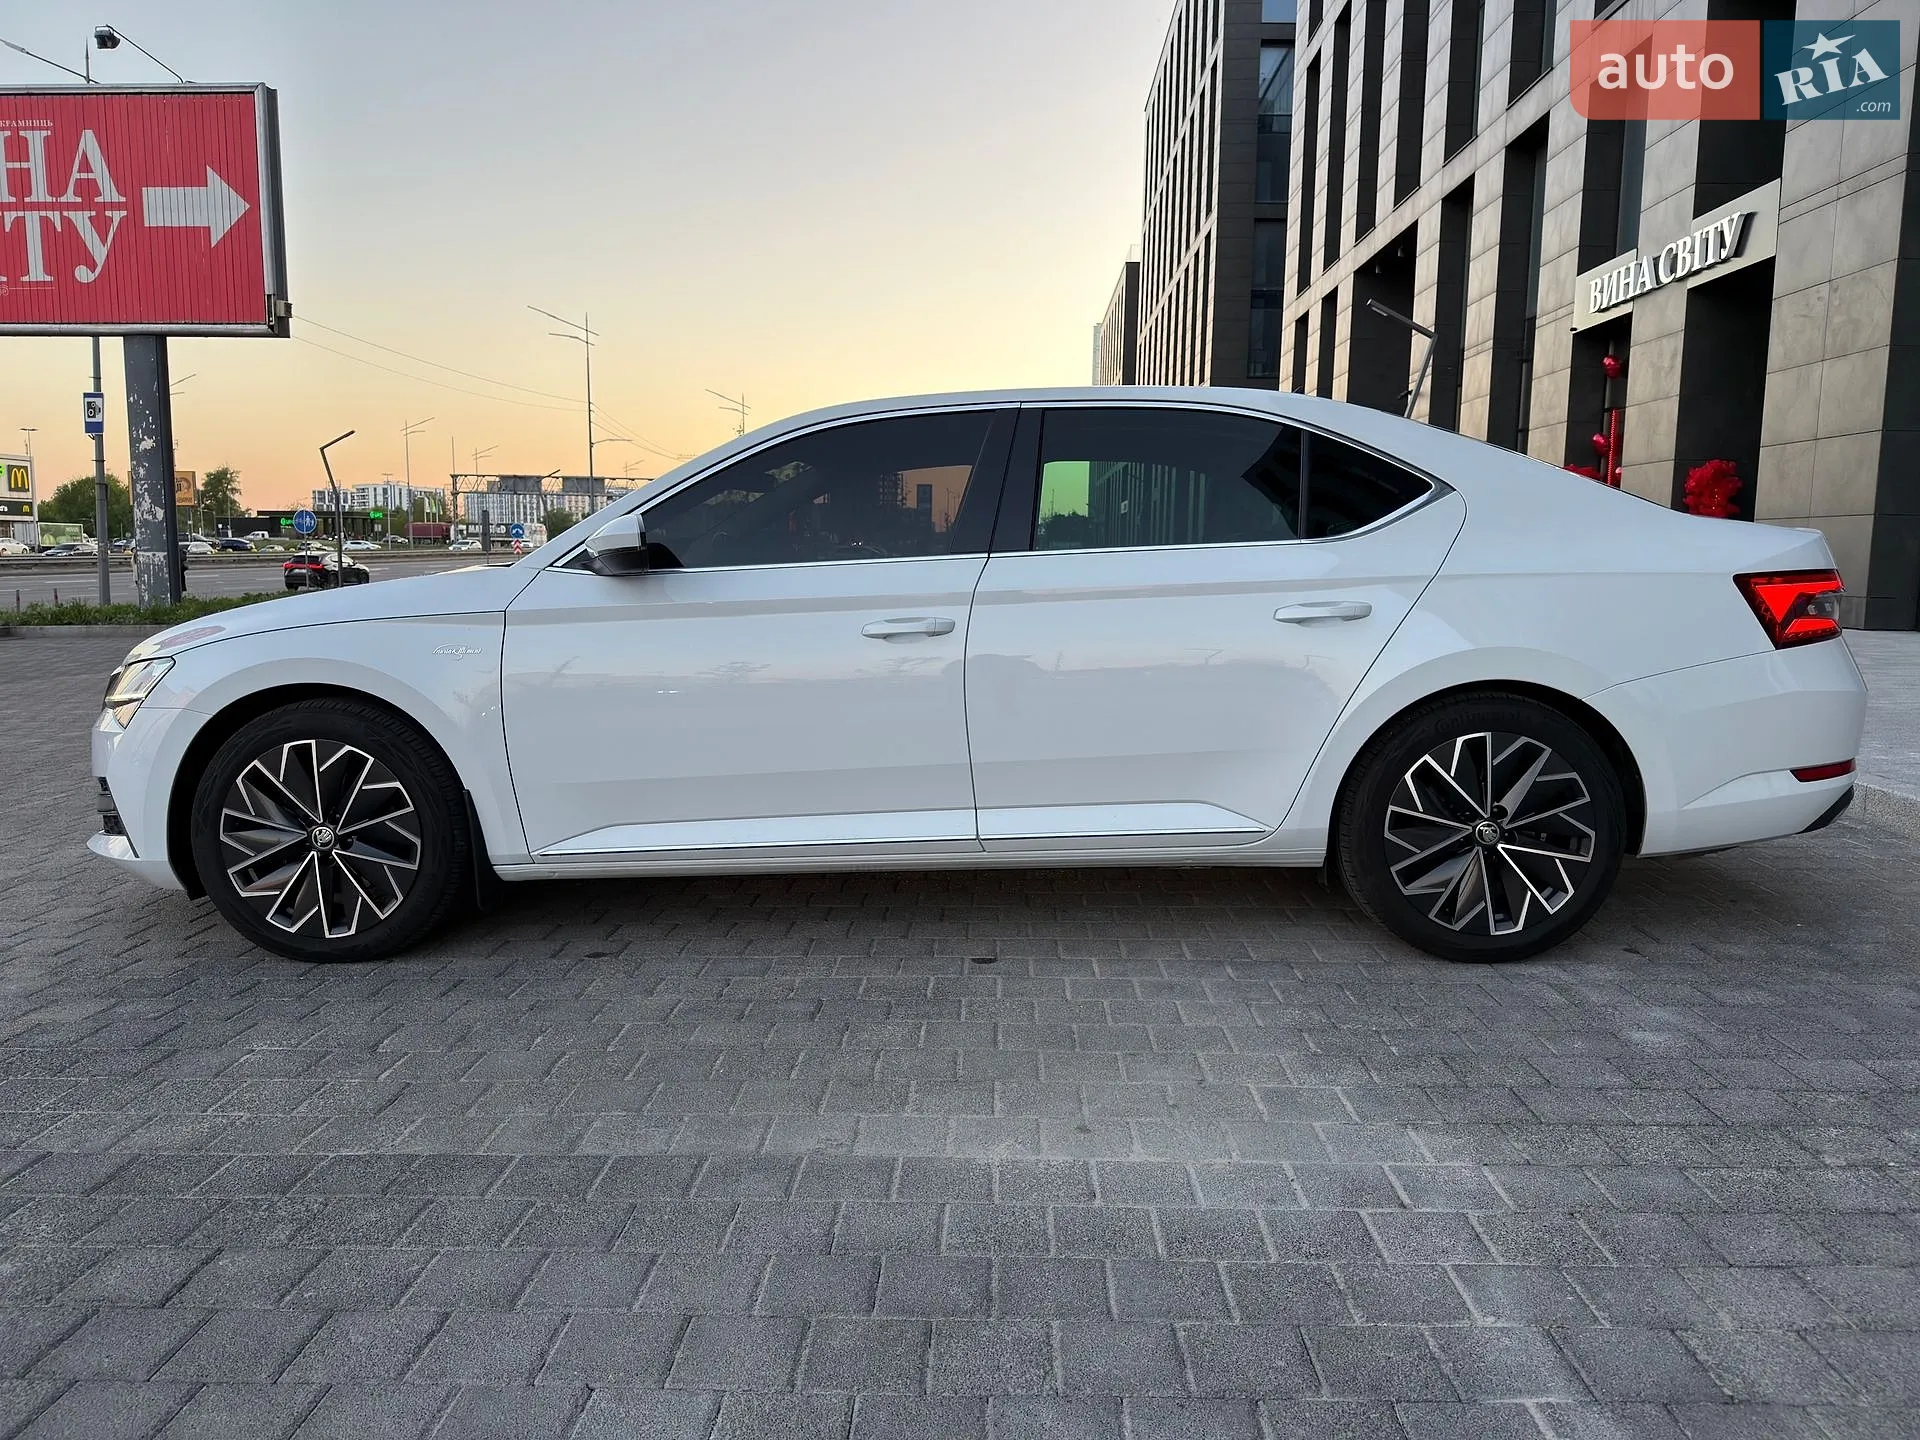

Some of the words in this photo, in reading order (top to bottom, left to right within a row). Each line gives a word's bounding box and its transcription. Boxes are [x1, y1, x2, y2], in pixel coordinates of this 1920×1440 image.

[0, 210, 128, 283] ТУ
[1588, 254, 1656, 314] ВИНА
[1658, 211, 1745, 285] СВІТУ
